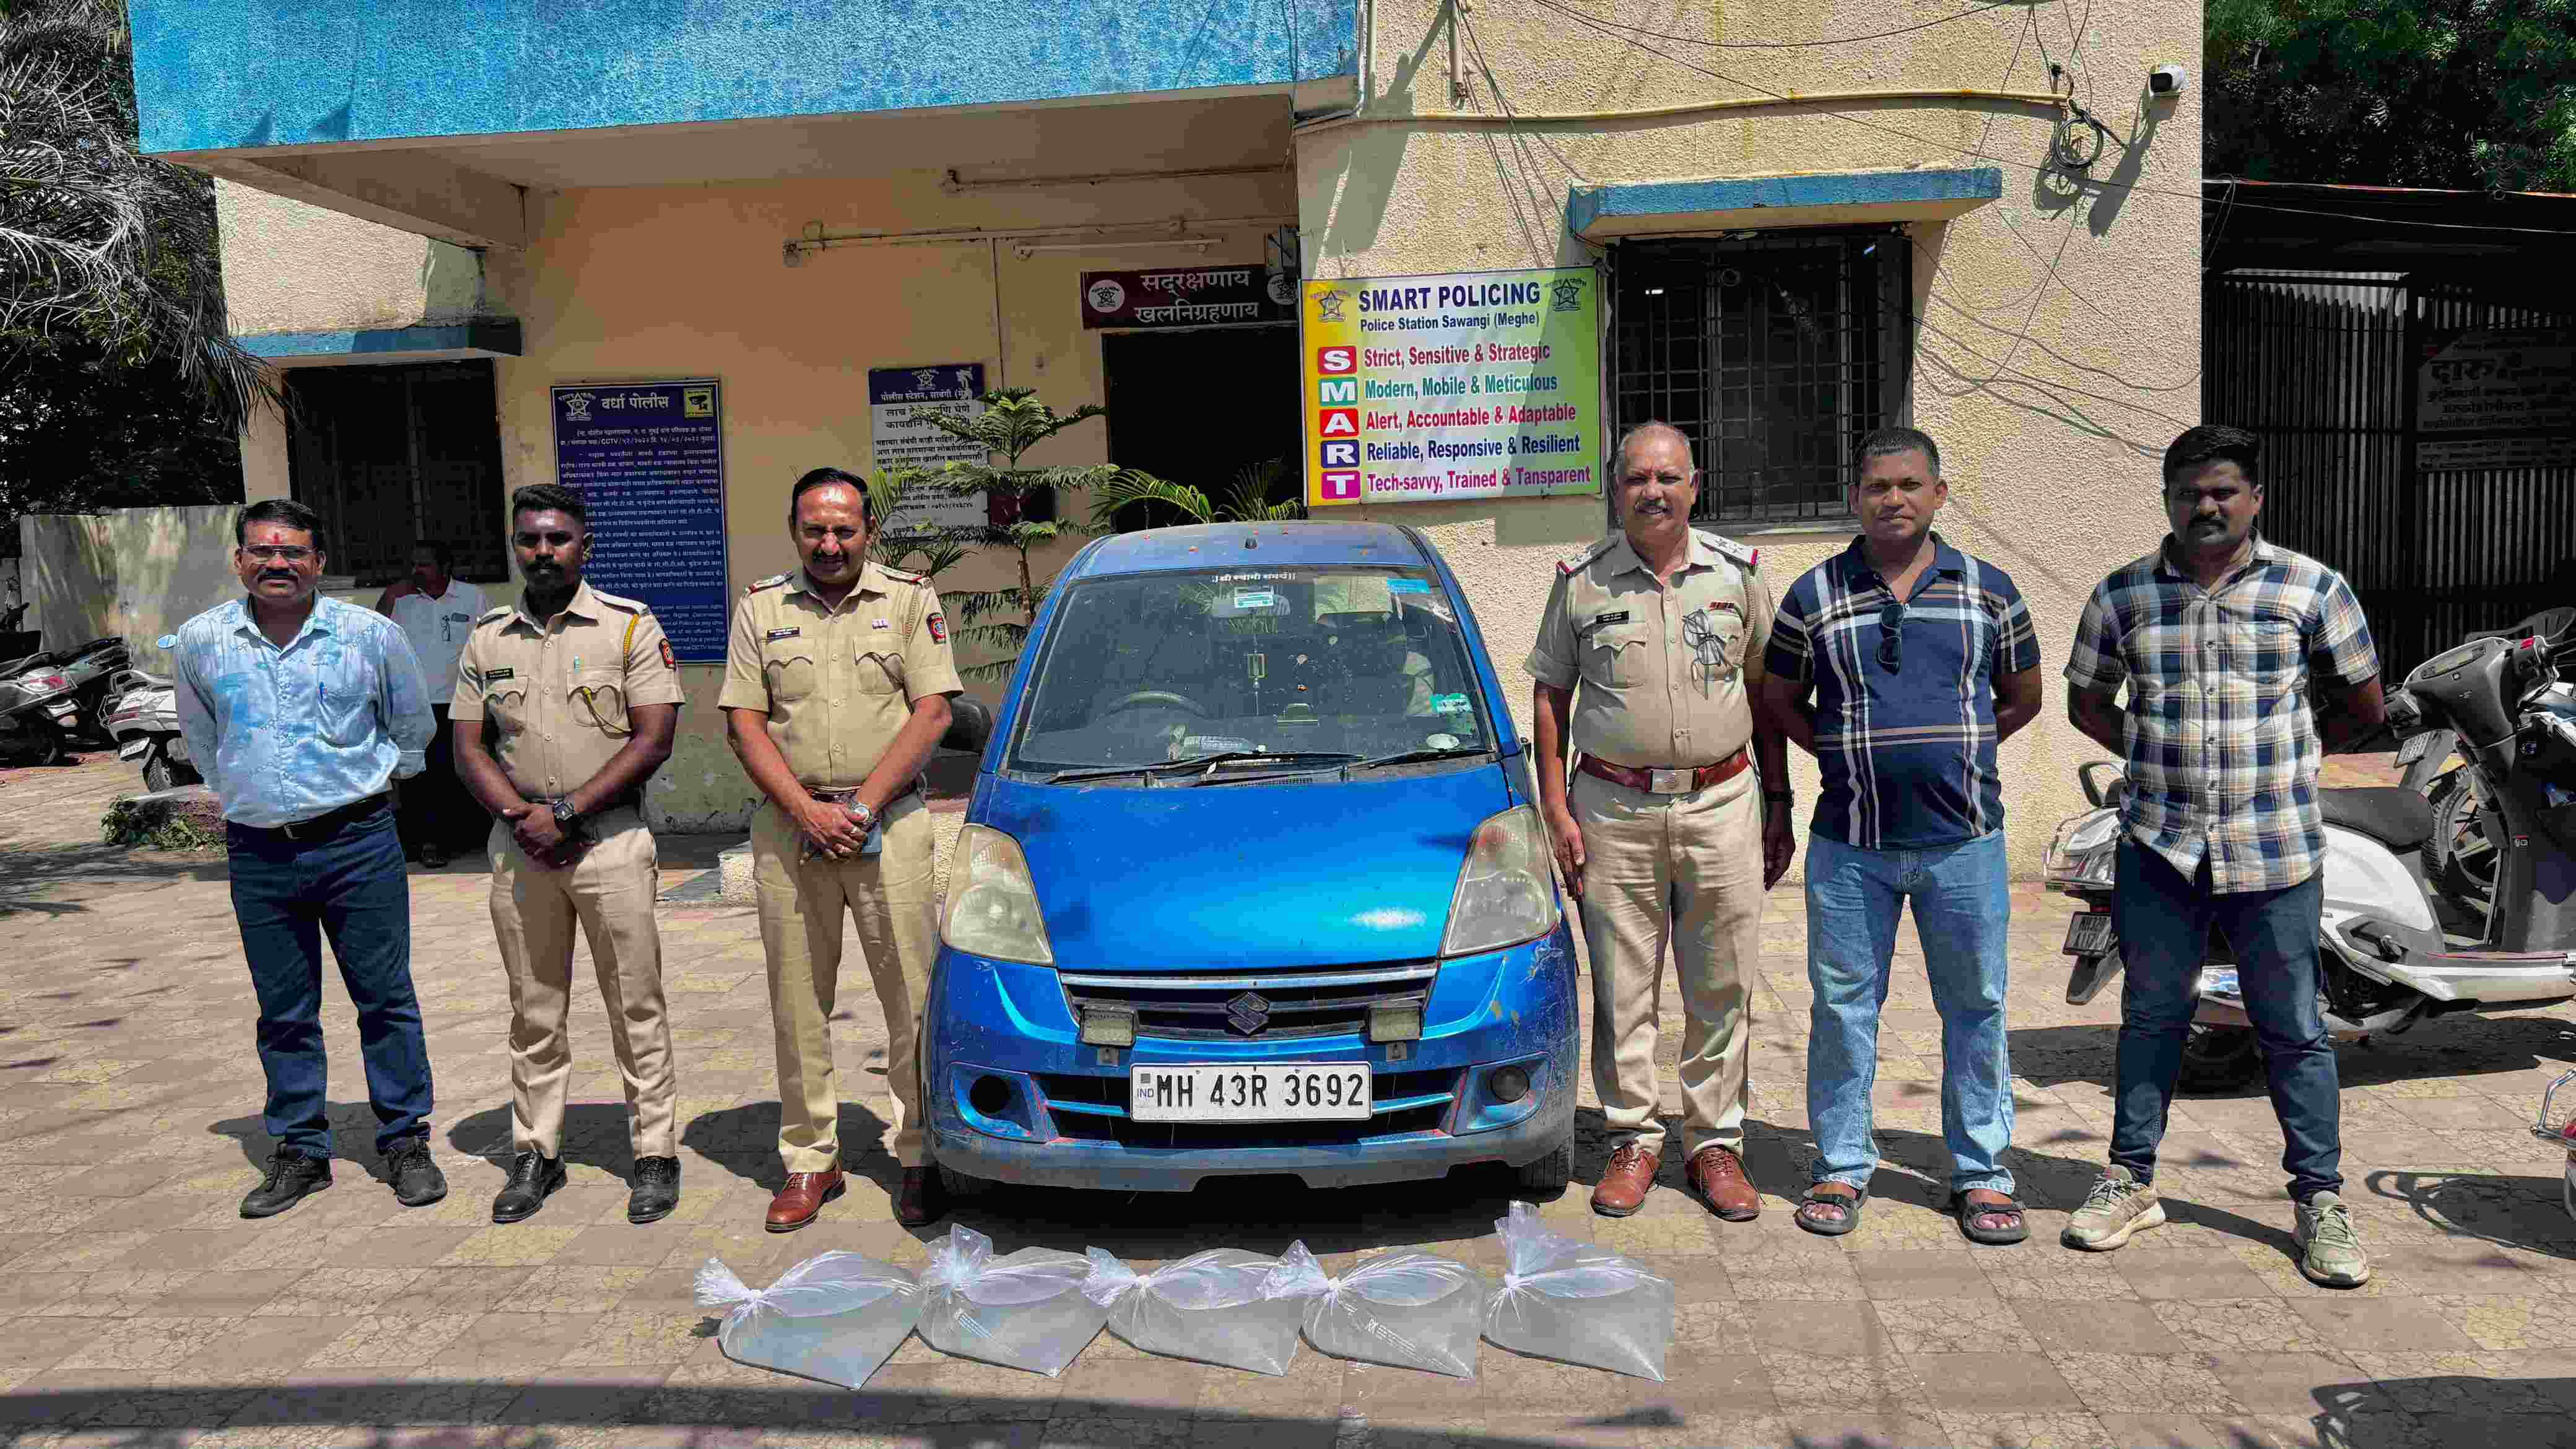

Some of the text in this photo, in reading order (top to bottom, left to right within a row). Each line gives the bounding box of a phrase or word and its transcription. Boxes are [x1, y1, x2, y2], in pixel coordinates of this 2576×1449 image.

[1359, 282, 1541, 312] SMART POLICING
[1133, 298, 1259, 323] खलनिग्रहणाय
[1360, 310, 1540, 332] Police Station Sawangi (Meghe)
[1323, 350, 1351, 371] S
[1364, 342, 1550, 370] Strict, Sensitive & Strategic
[1321, 381, 1356, 402] M
[1365, 374, 1557, 401] Modern, Mobile & Meticulous
[600, 393, 625, 410] वर्धा
[629, 392, 669, 410] पोलीस
[1323, 413, 1356, 434] A
[1365, 402, 1577, 432] Alert, Accountable & Adaptable
[1326, 443, 1356, 465] R
[1367, 434, 1580, 463] Reliable, Responsive & Resilient
[1326, 475, 1355, 495] T
[1367, 466, 1591, 494] Tech-savvy, Trained & Tansparent
[1137, 1088, 1154, 1099] IND
[1156, 1073, 1364, 1107] MH 43R 3692
